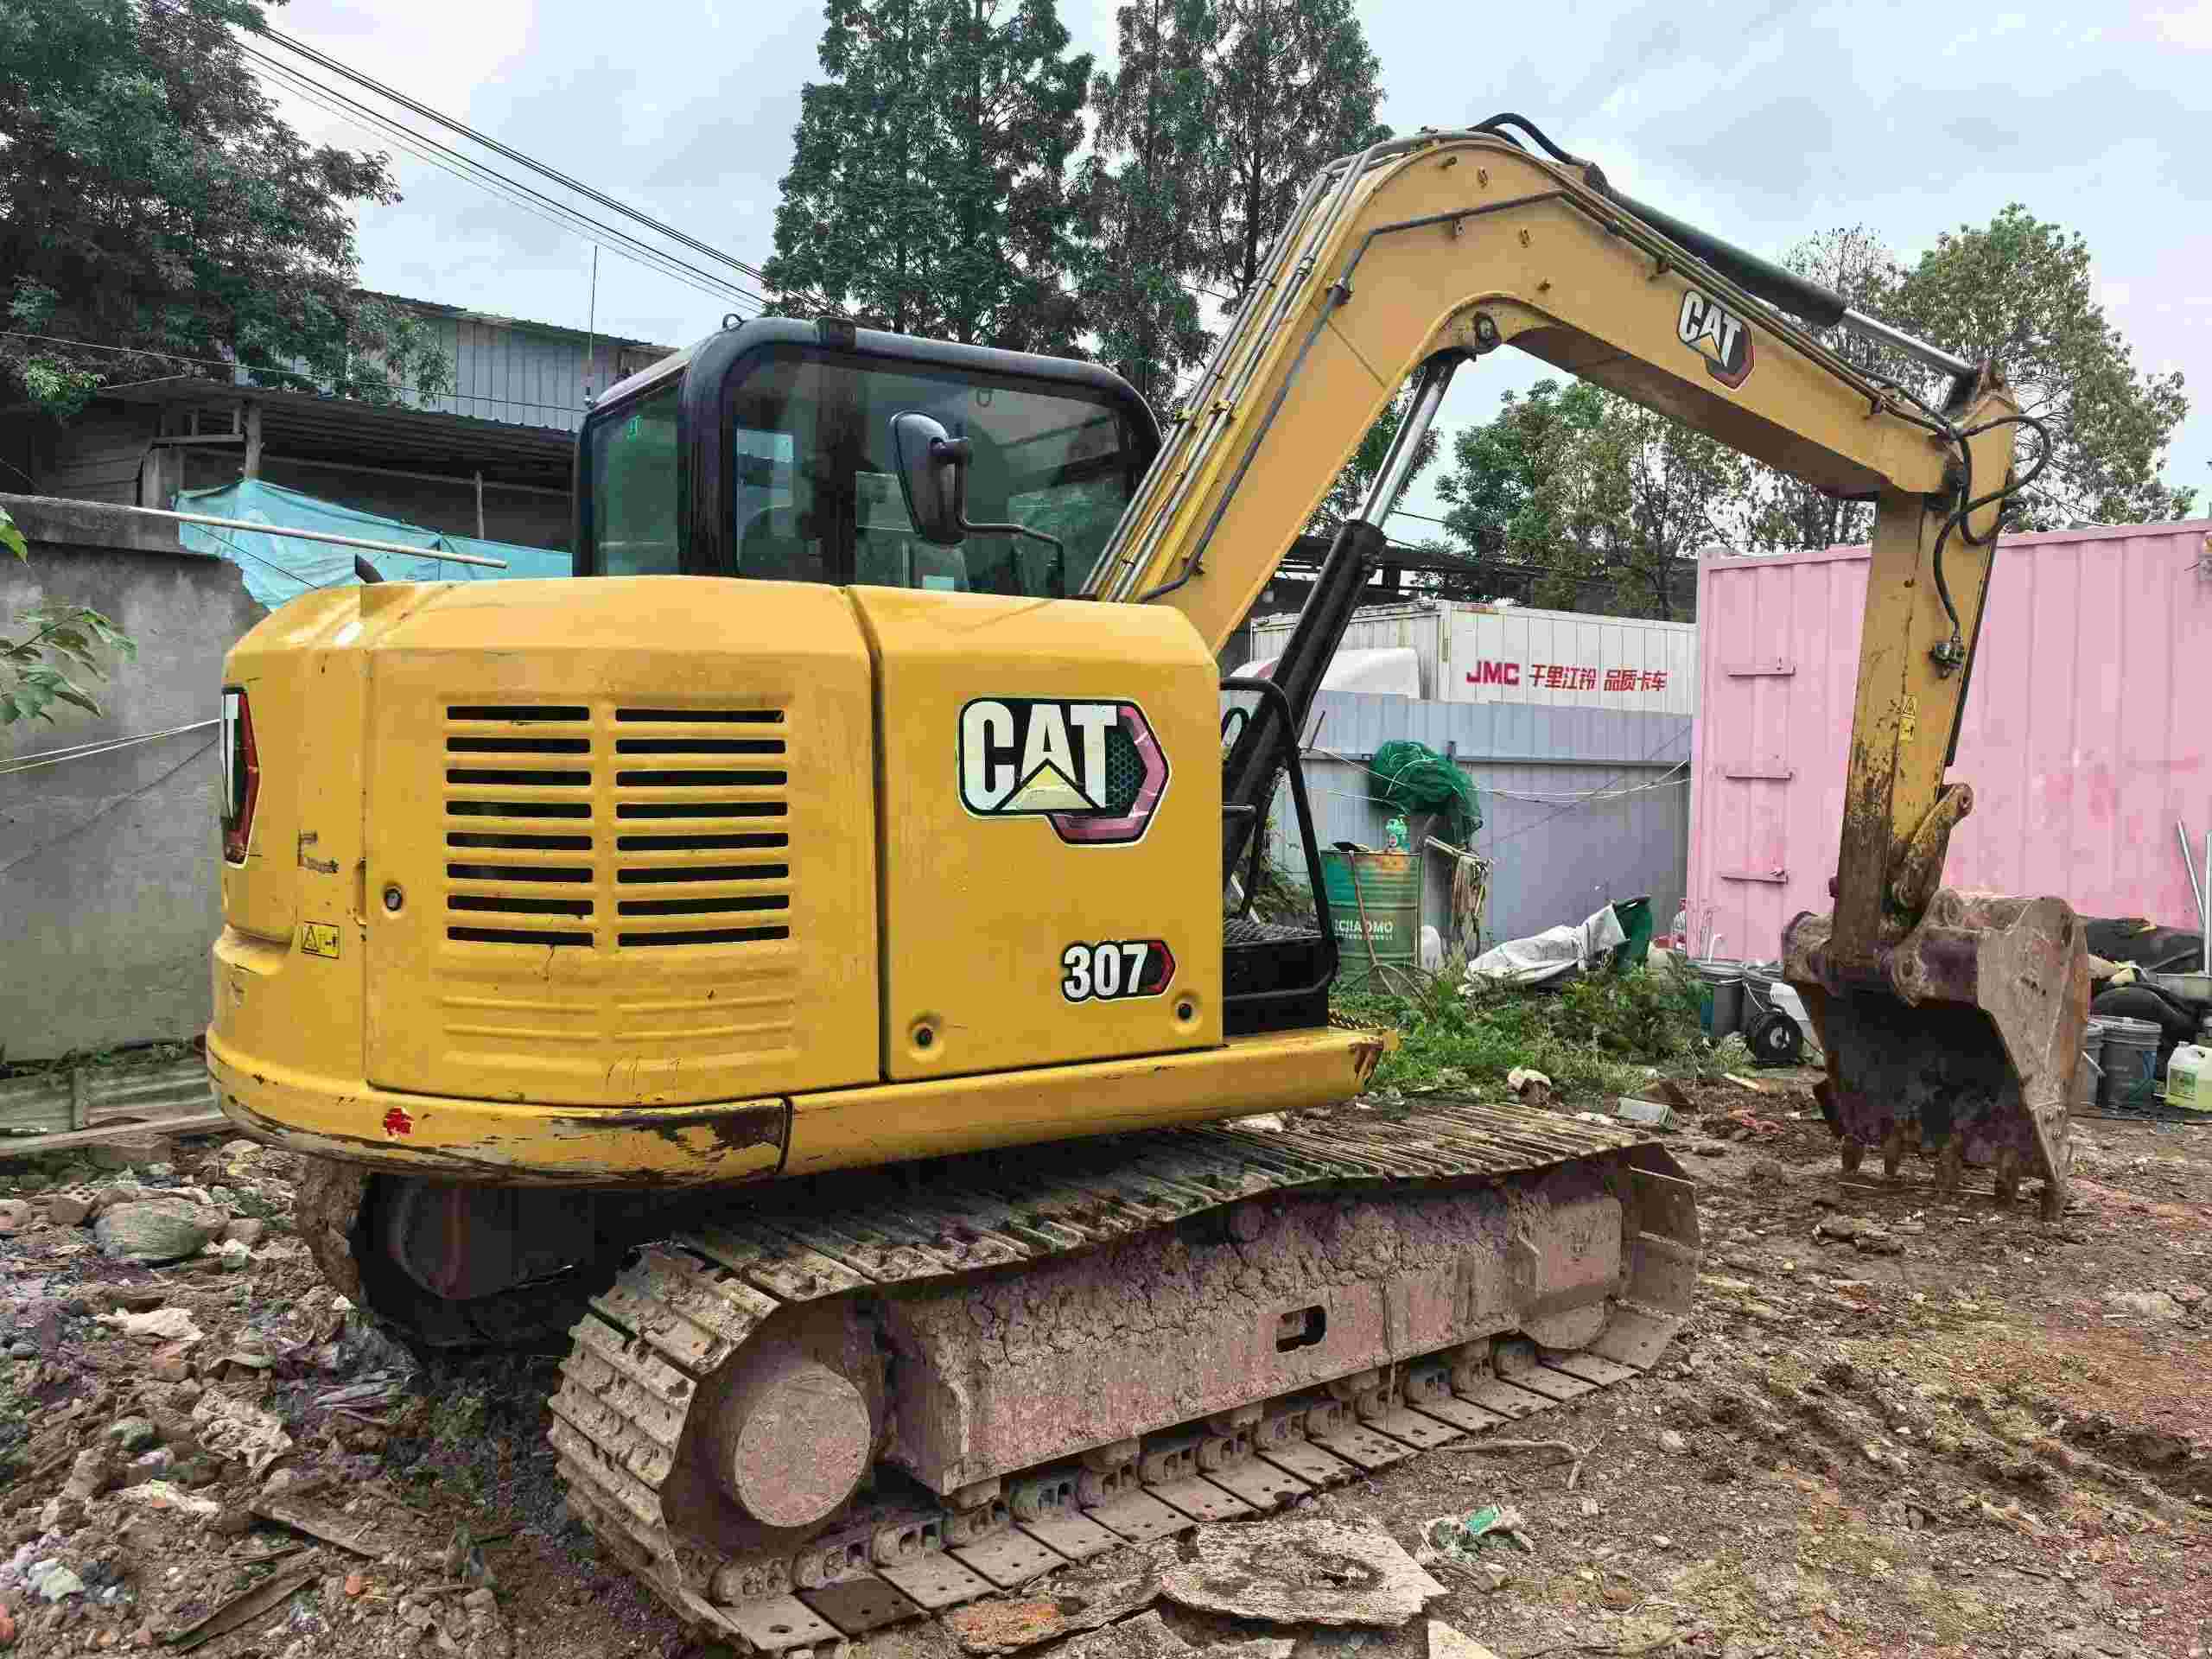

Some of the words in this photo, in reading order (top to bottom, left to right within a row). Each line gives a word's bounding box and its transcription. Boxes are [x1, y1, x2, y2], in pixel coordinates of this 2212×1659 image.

[1678, 290, 1742, 367] CAT
[1465, 660, 1520, 686] JMC
[1528, 664, 1598, 690] 千里江铃
[1603, 667, 1669, 692] 品质卡车
[962, 700, 1118, 811] CAT
[1063, 943, 1148, 999] 307
